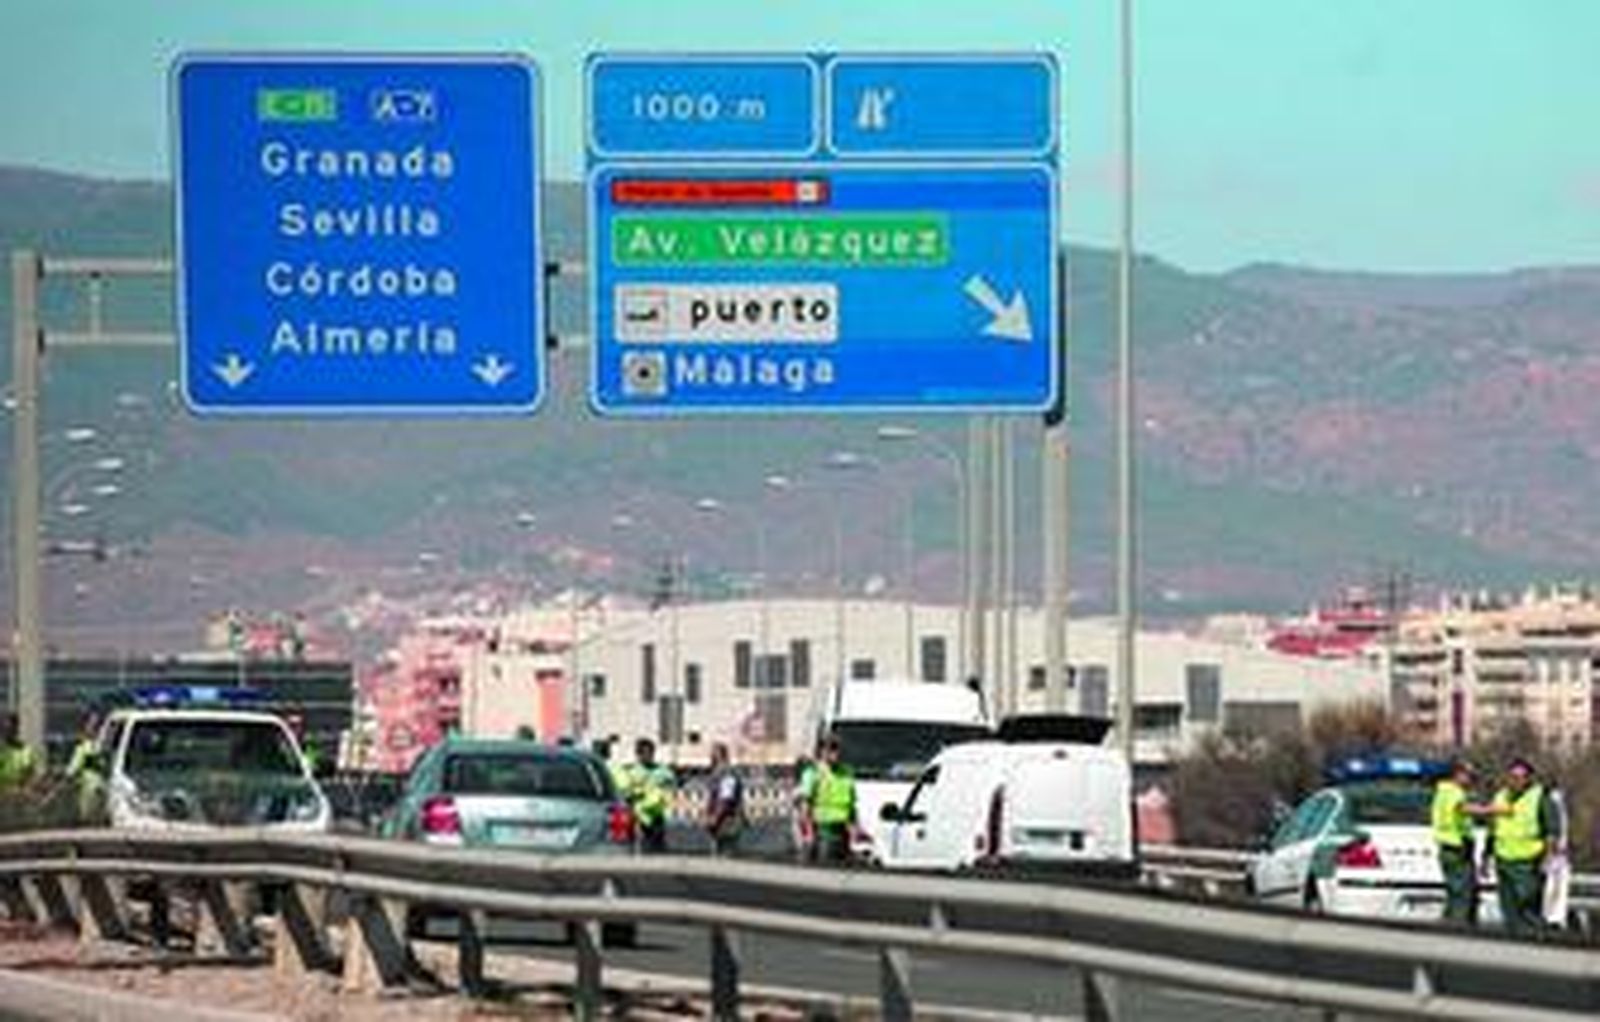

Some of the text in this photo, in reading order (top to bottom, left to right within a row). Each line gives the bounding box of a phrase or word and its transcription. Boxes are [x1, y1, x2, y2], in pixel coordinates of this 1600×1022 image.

[633, 92, 766, 120] 1000 m
[261, 141, 454, 177] Granada
[279, 202, 440, 237] Sevilla
[718, 224, 938, 263] Velázquez
[266, 261, 456, 296] Córdoba
[690, 295, 831, 330] puerto
